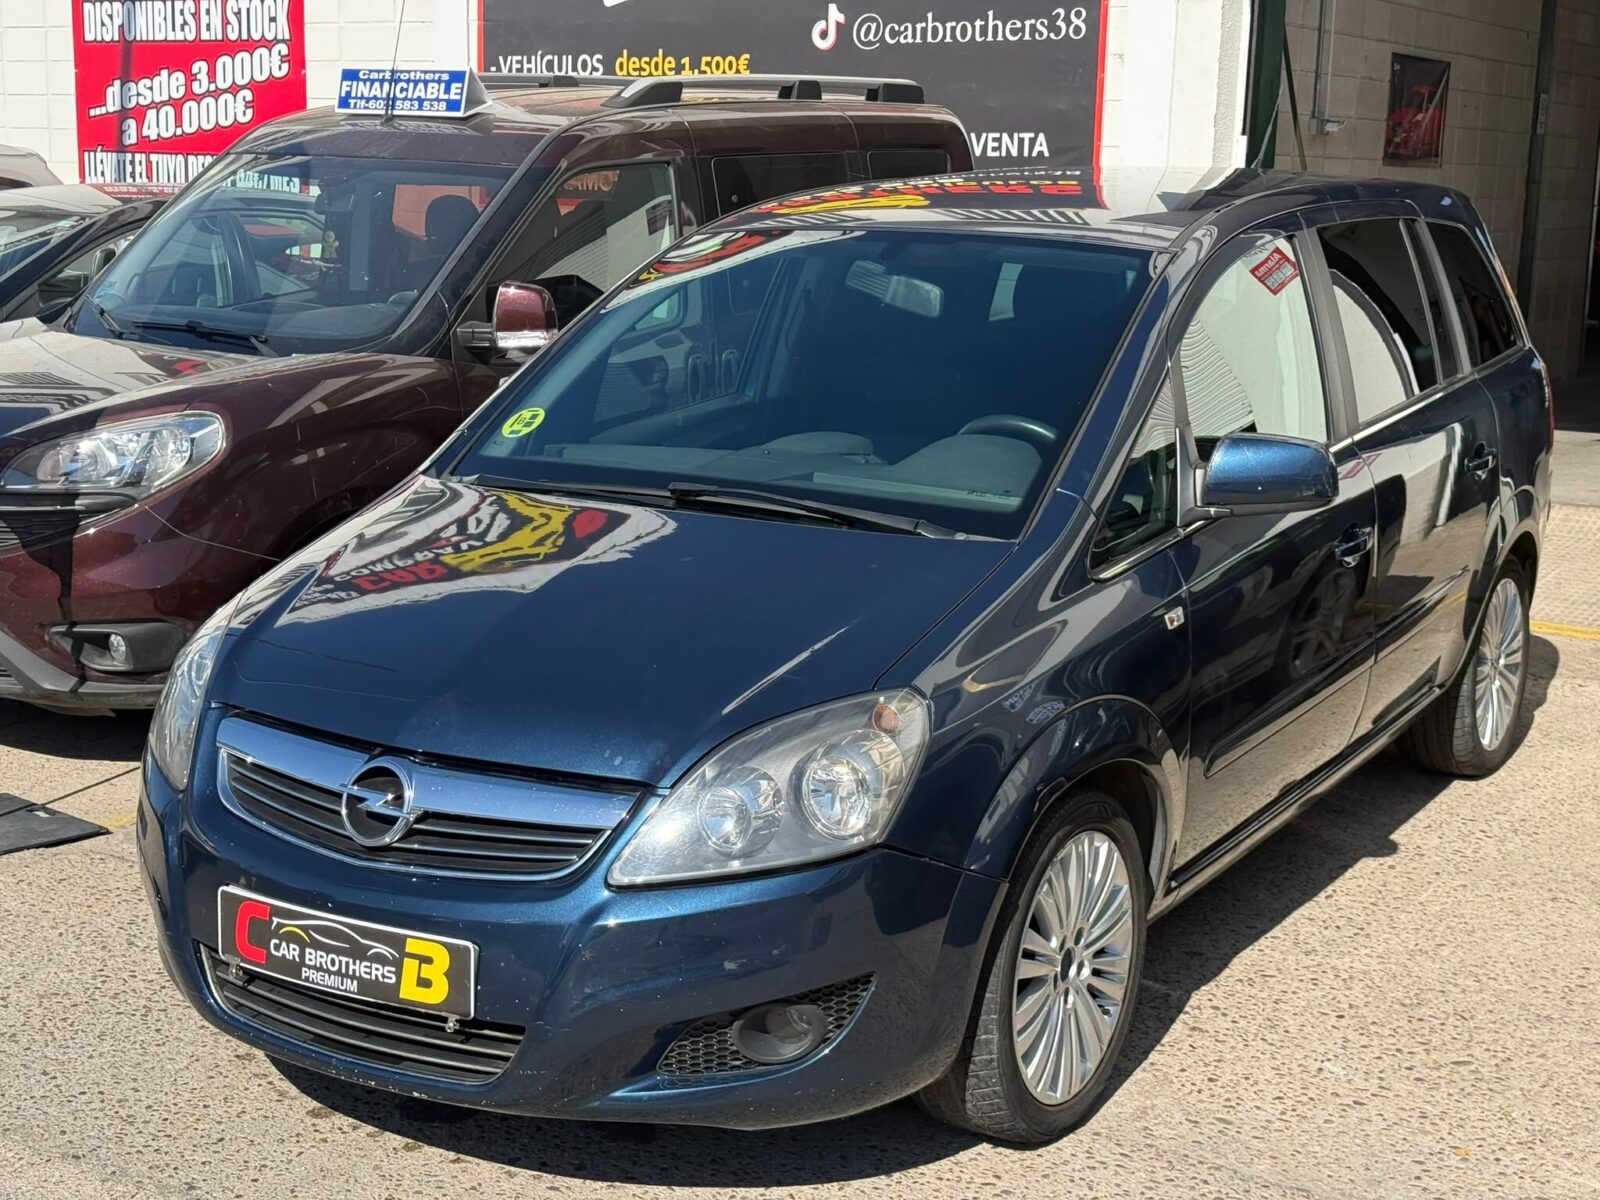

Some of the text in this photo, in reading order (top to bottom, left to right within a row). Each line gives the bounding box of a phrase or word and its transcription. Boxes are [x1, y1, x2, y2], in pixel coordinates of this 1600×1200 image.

[83, 0, 291, 42] DISPONIBLES EN STOCK
[852, 7, 1087, 50] @carbrothers38
[191, 43, 290, 95] 3.000€
[499, 51, 603, 75] VEHÍCULOS
[615, 49, 675, 76] desde
[681, 54, 750, 76] 1.500€
[341, 81, 462, 100] FINANCIABLE
[395, 100, 419, 110] 583
[422, 101, 447, 111] 538
[121, 89, 253, 146] a 40.000€
[970, 132, 1050, 157] VENTA
[83, 145, 133, 184] LLÉVATE
[134, 152, 149, 184] EL
[150, 153, 185, 184] TUYO
[234, 900, 451, 1005] C CAR BROTHERS B
[301, 967, 358, 993] PREMIUM
